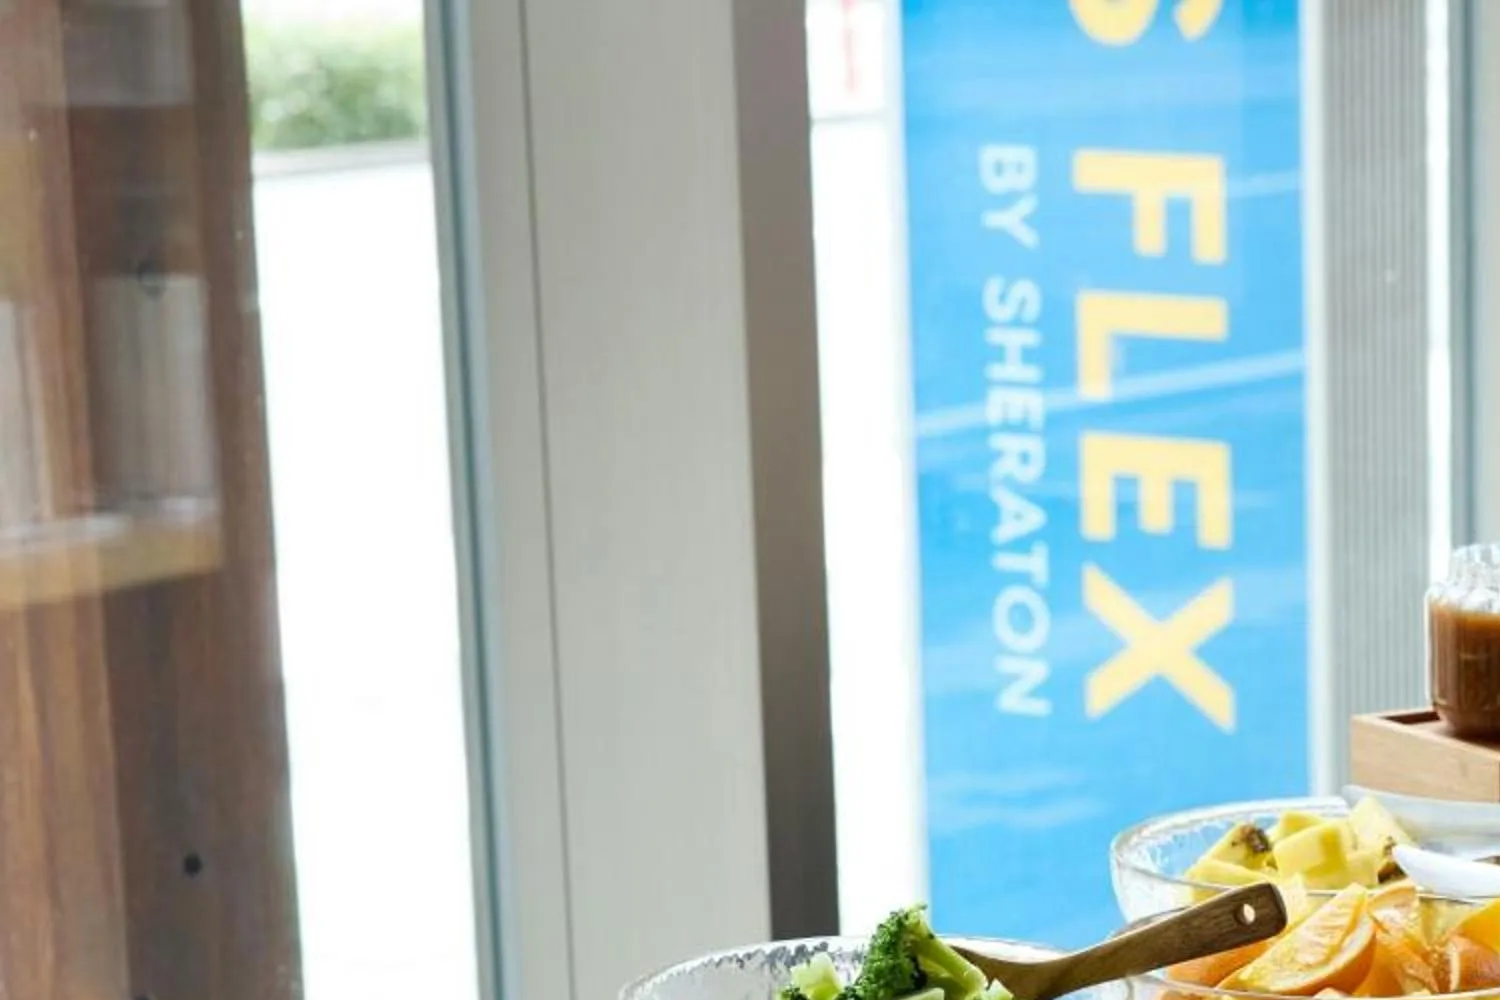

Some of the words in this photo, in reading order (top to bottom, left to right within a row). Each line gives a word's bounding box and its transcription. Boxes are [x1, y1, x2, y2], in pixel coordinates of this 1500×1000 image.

[979, 145, 1038, 248] BY
[984, 277, 1051, 715] SHERATON
[1073, 150, 1235, 731] FLEX
